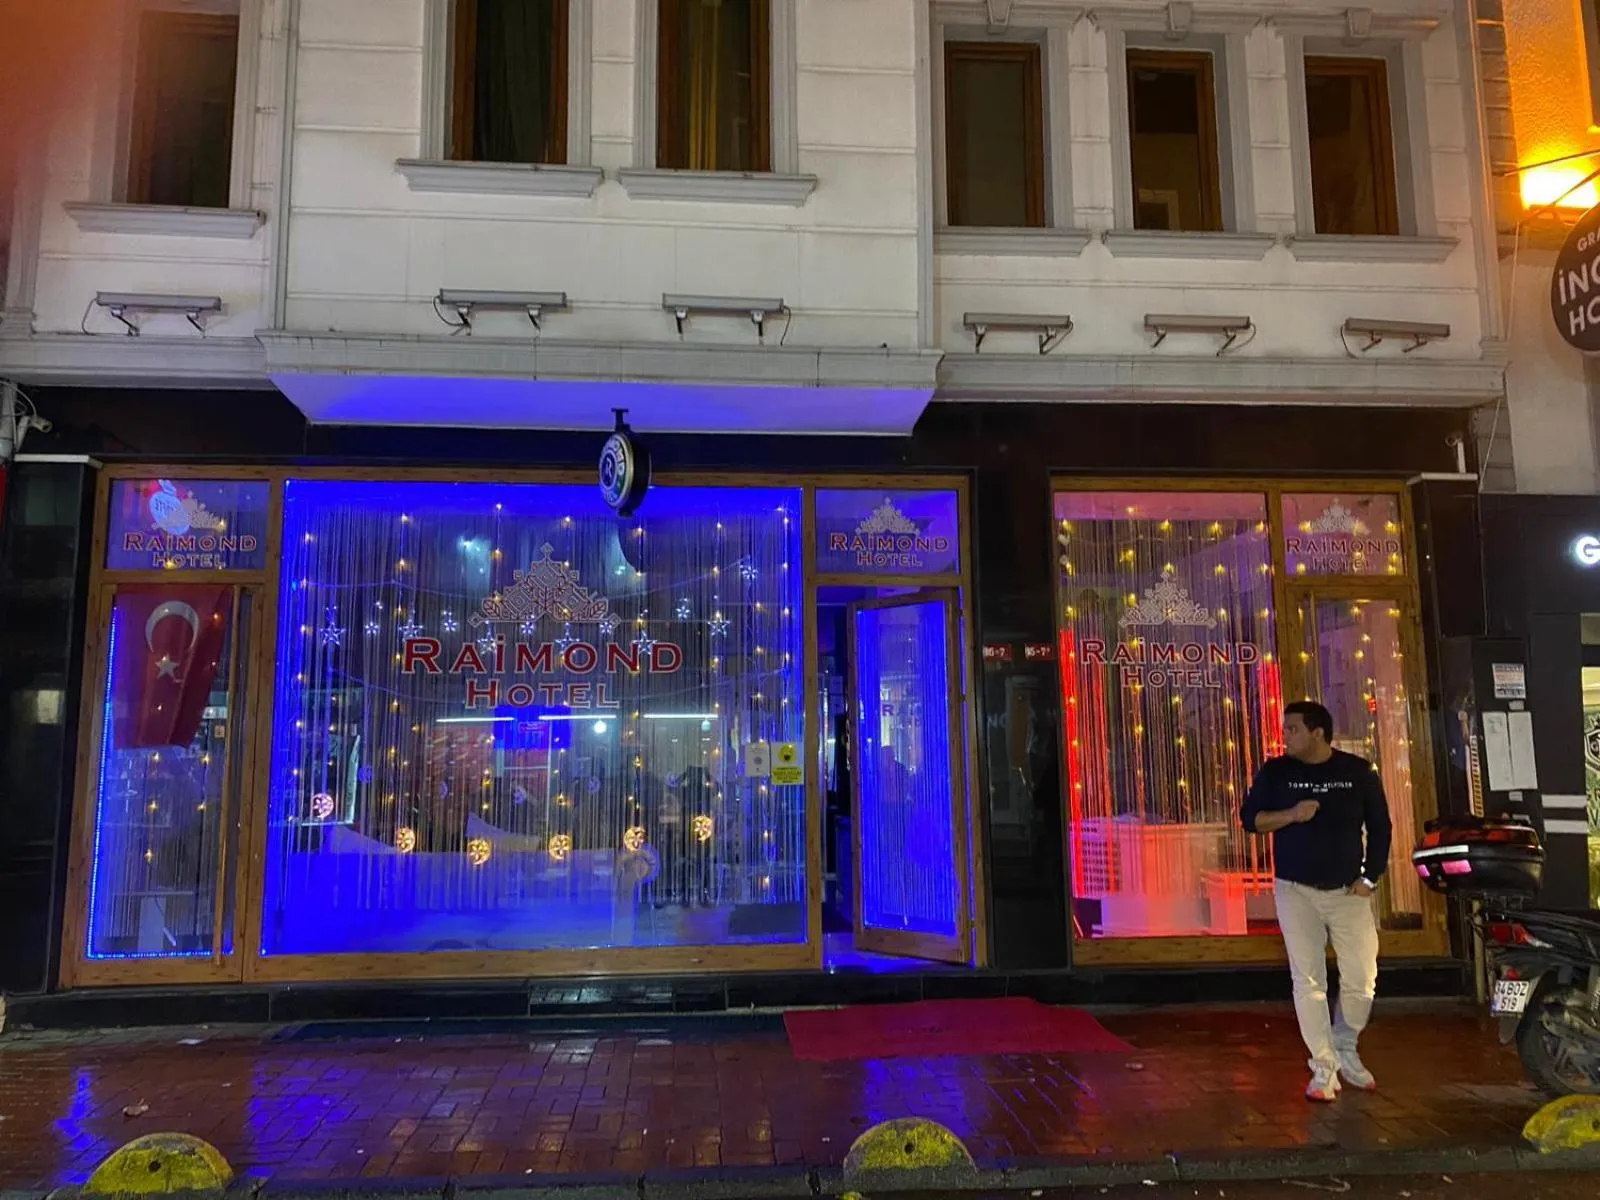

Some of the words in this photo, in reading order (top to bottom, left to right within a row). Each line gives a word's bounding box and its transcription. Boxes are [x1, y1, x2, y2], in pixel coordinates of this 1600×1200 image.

[152, 551, 226, 568] HOTEL
[856, 551, 923, 567] HOTEL
[1121, 667, 1221, 688] HOTEL
[465, 679, 620, 709] HOTEL
